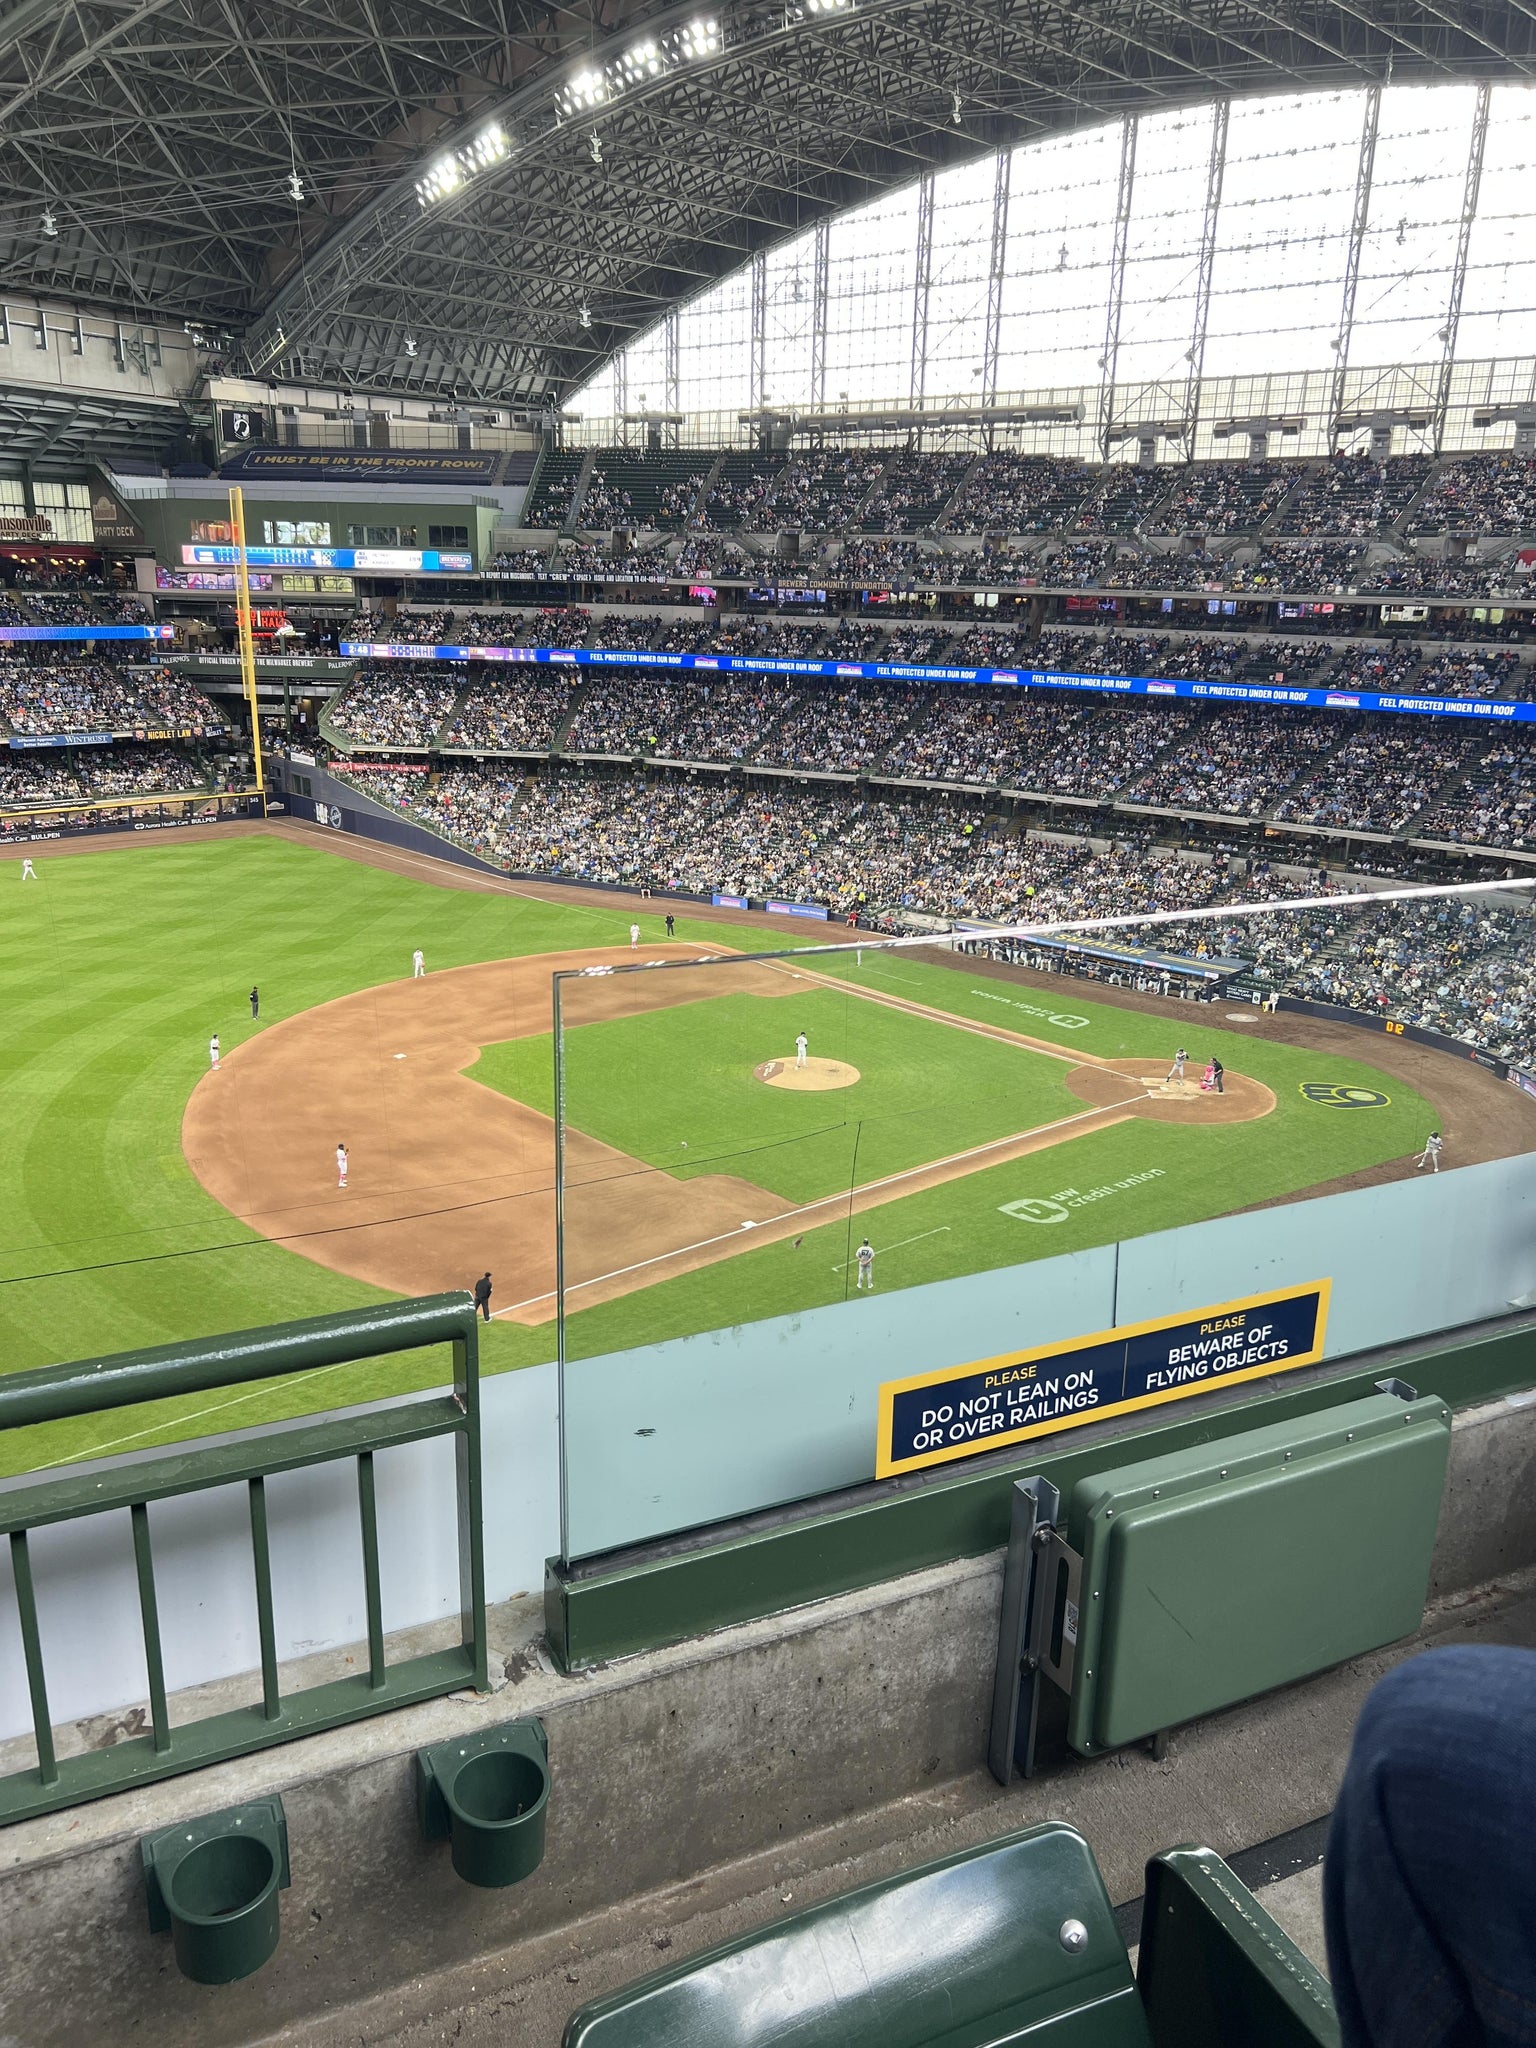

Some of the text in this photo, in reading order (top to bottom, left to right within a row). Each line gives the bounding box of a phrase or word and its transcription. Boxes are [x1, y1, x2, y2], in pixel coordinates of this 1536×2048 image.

[262, 456, 307, 464] MUST
[309, 456, 328, 464] BE
[353, 458, 383, 466] THE
[385, 459, 439, 467] FRONT
[441, 460, 485, 468] ROW!
[94, 525, 135, 537] PARTY DECK
[778, 580, 893, 590] BREWERS COMMUNITY FOUNDATION
[348, 645, 369, 654] 2:48
[160, 655, 190, 664] PALERMO'S
[198, 657, 219, 665] OFFICIAL
[256, 658, 265, 666] THE
[266, 659, 292, 667] MILWAUKEE
[590, 653, 604, 661] FEEL
[605, 654, 638, 662] PROTECTED
[638, 655, 656, 663] UNDER
[731, 660, 744, 668] FEEL
[745, 661, 775, 669] PROTECTED
[808, 664, 823, 672] ROOF
[877, 667, 977, 679] FEEL PROTECTED UNDER OUR ROOF
[1032, 674, 1132, 689] FEEL PROTECTED UNDER OUR ROOF
[1192, 685, 1308, 701] FEEL PROTECTED UNDER OUR ROOF
[1379, 697, 1516, 716] FEEL PROTECTED UNDER OUR ROOF
[147, 729, 192, 740] NICOLET LAW
[191, 817, 217, 825] BULLPEN
[31, 832, 61, 840] BULLPEN
[1067, 1167, 1167, 1208] credit union
[1050, 1187, 1080, 1201] uw
[1200, 1314, 1247, 1336] PLEASE
[1168, 1325, 1273, 1365] BEWARE OF
[1146, 1339, 1289, 1390] FLYING OBJECTS
[984, 1365, 1038, 1389] PLEASE
[922, 1369, 1094, 1428] DO NOT LEAN ON
[912, 1388, 1099, 1450] OR OVER RAILINGS
